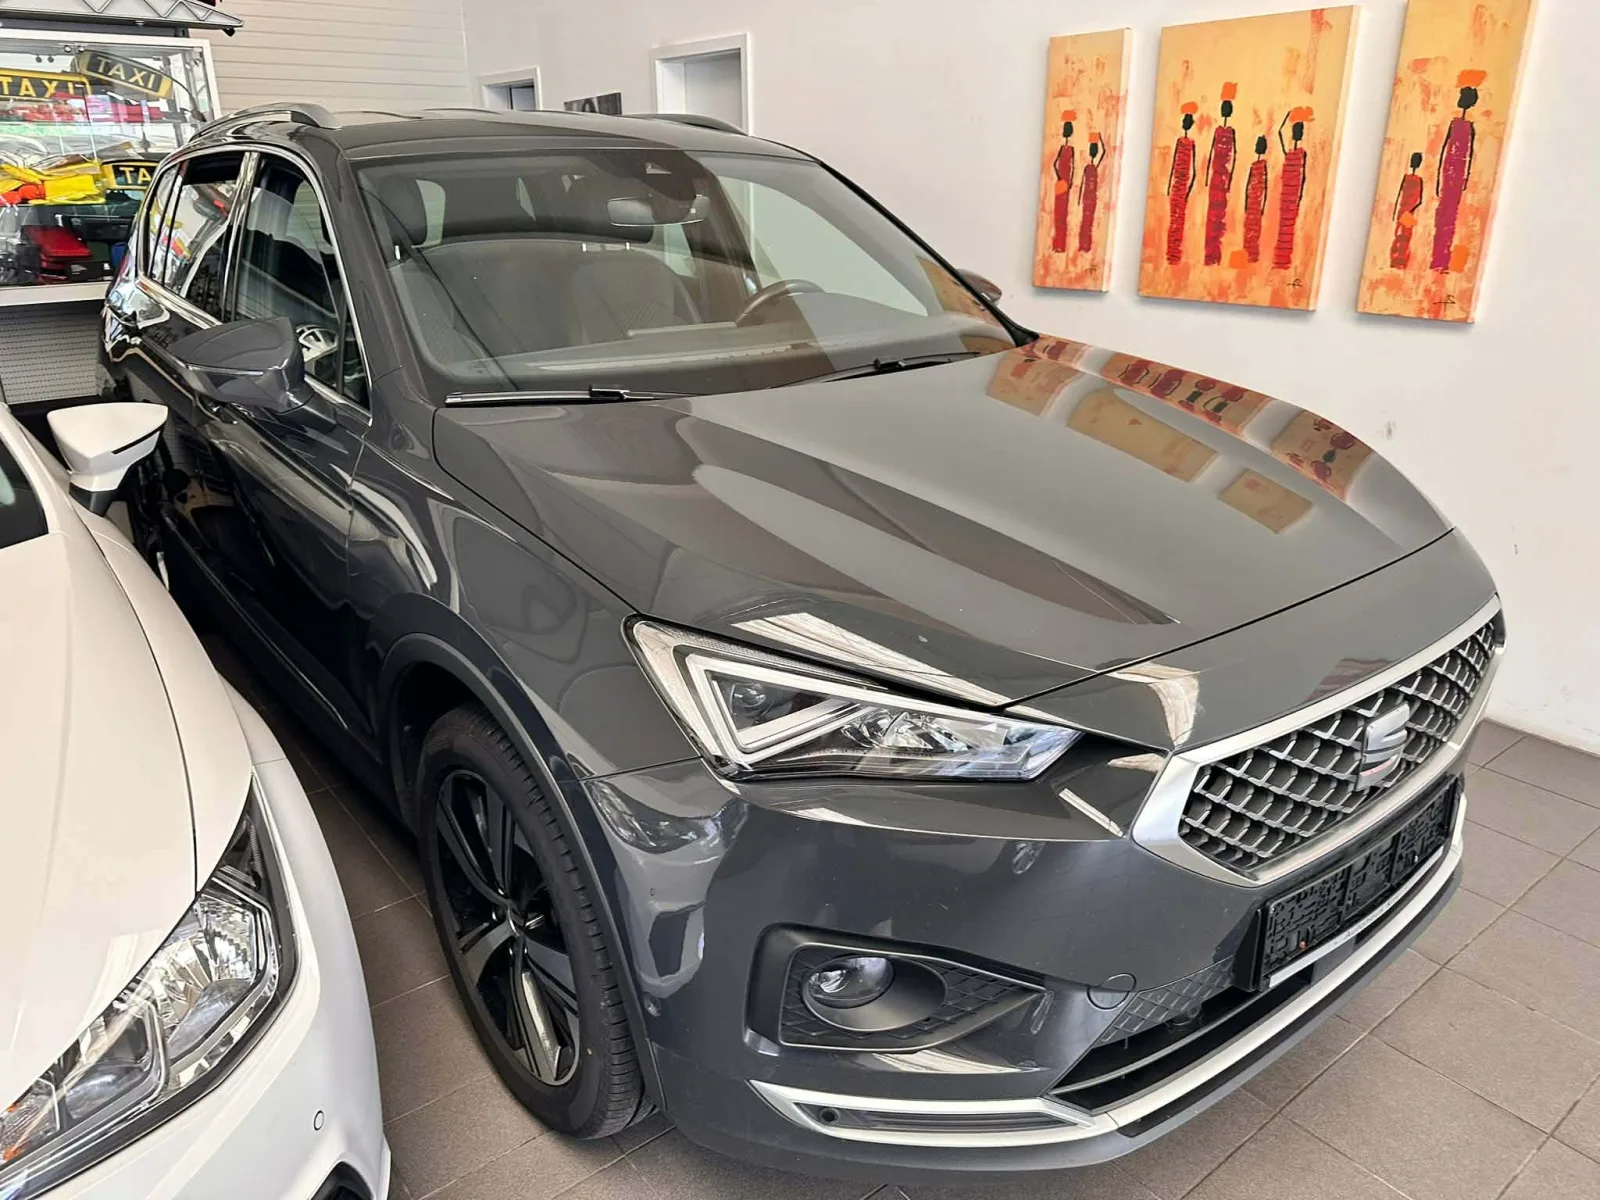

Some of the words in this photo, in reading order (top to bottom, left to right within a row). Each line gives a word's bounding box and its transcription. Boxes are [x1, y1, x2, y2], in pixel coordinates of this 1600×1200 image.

[95, 56, 157, 89] TAXI
[0, 76, 75, 98] TAXI
[119, 166, 152, 184] TA
